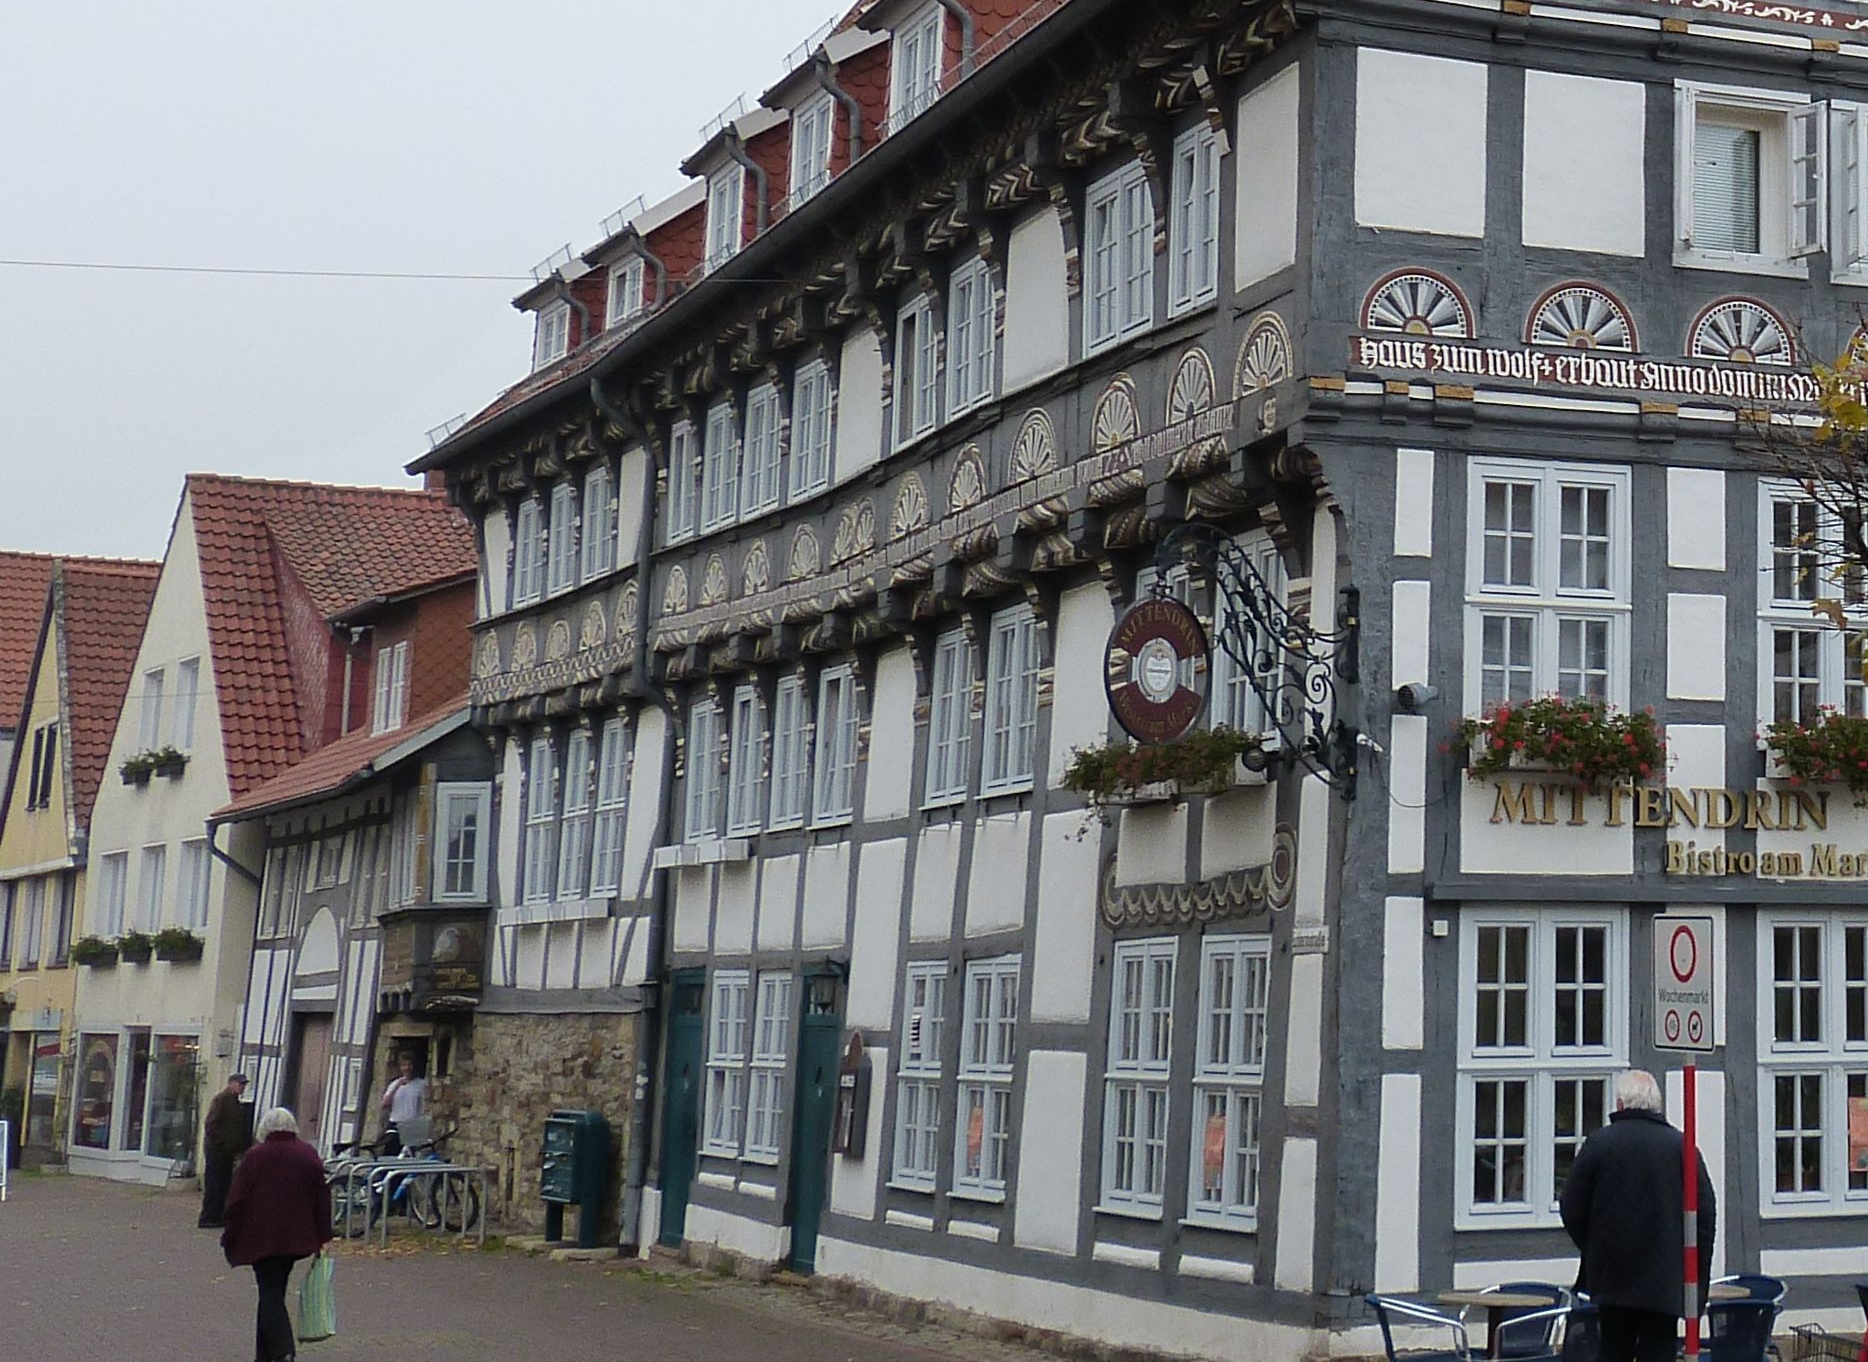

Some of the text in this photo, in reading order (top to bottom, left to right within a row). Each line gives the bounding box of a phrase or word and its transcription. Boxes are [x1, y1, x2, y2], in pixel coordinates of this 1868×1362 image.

[1430, 344, 1485, 374] zum
[1554, 353, 1637, 389] erbaut
[1490, 780, 1831, 830] MITTENDRIN
[1665, 840, 1755, 874] Bistro
[1761, 851, 1803, 876] am
[1658, 987, 1709, 1004] Wochenmarkt
